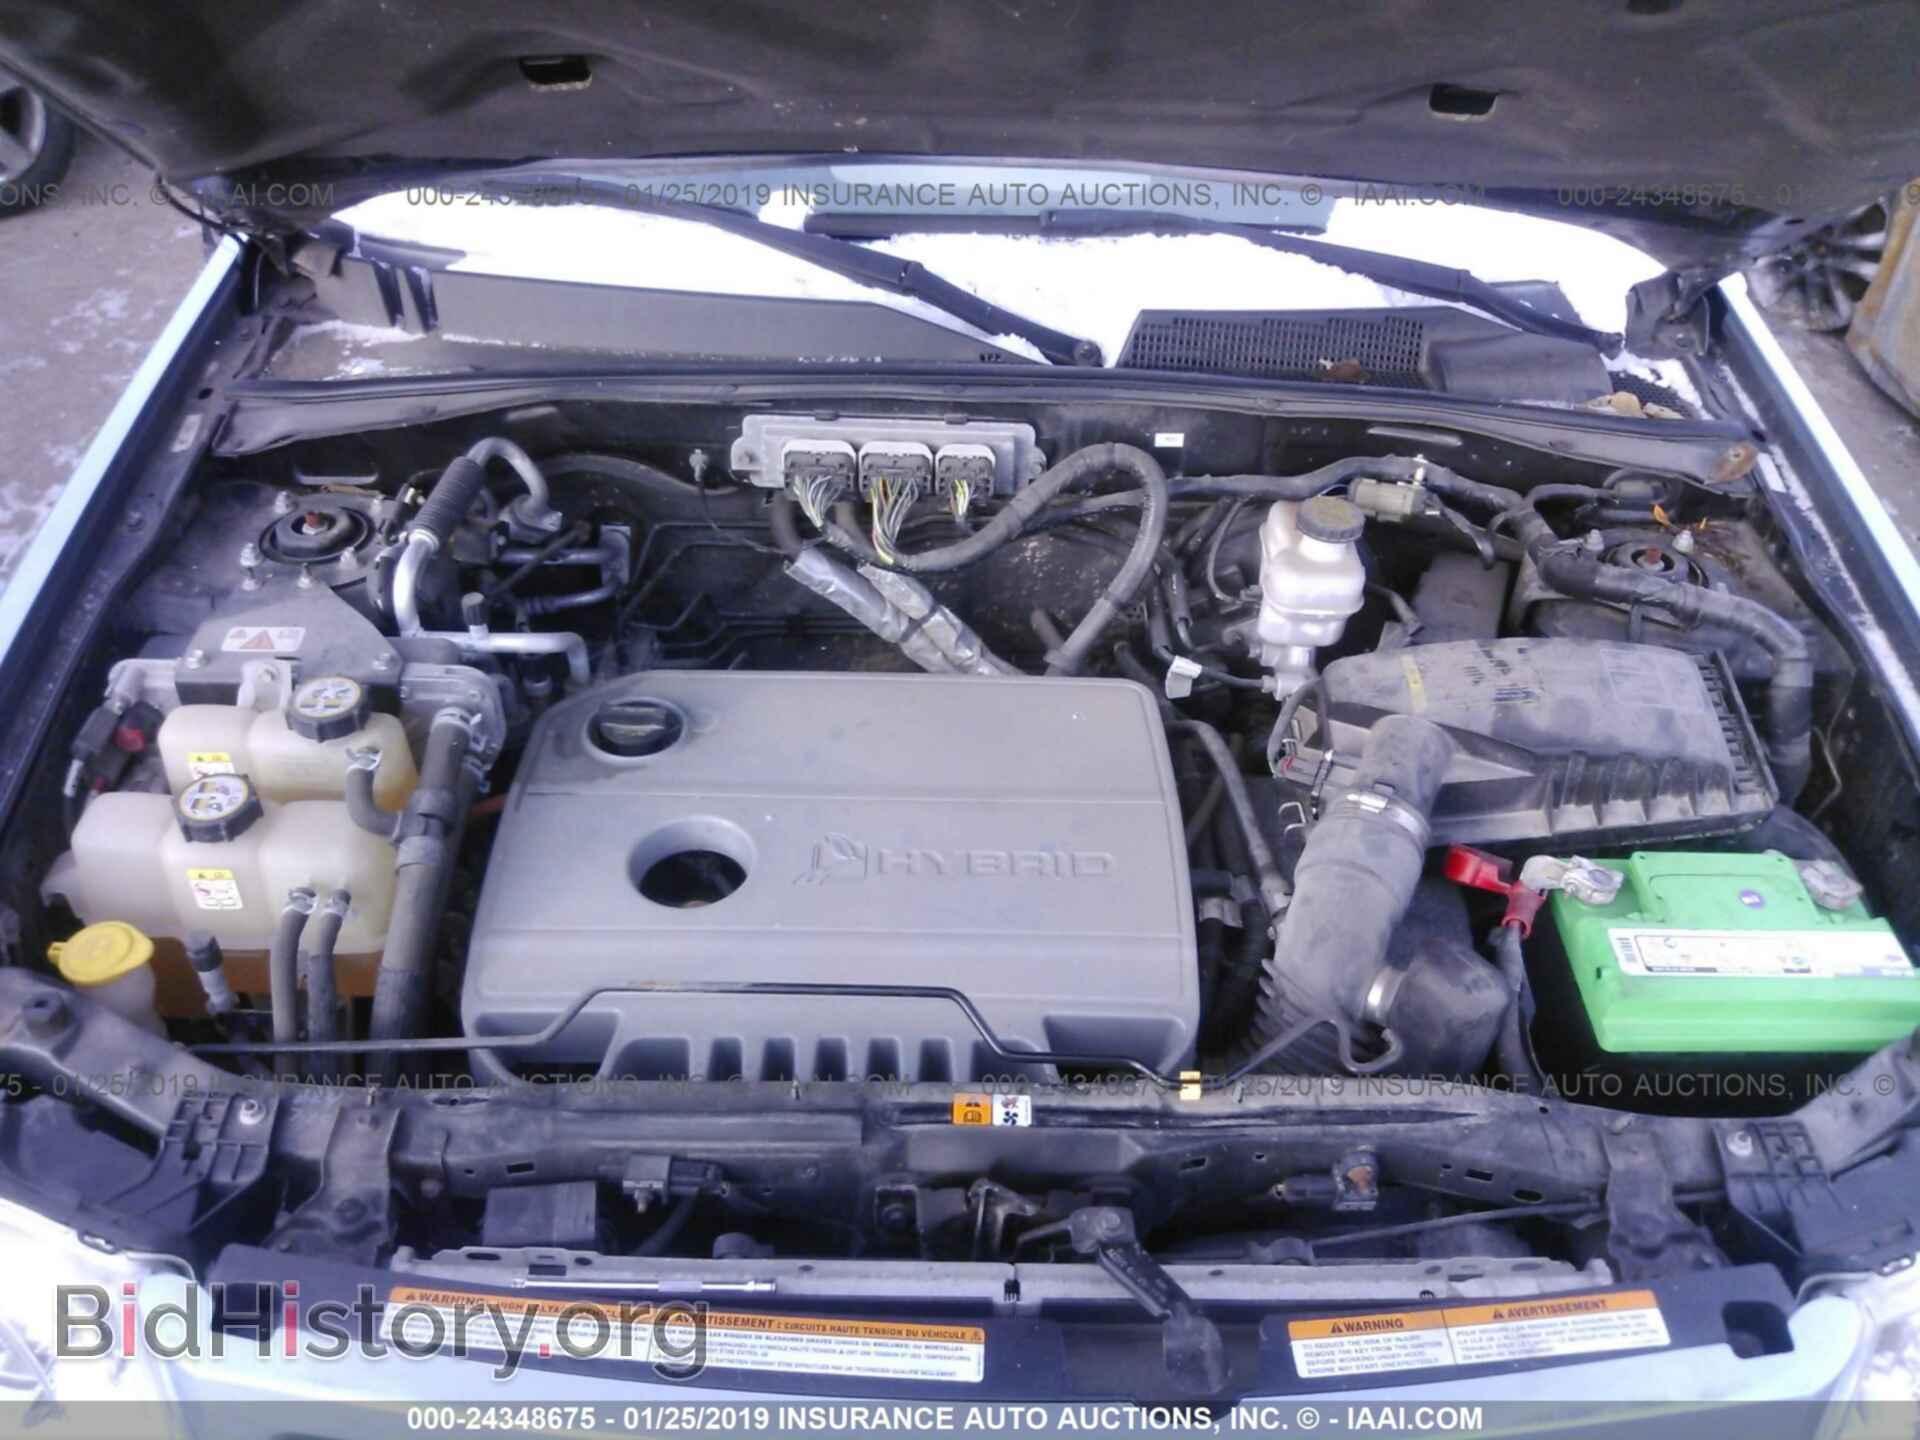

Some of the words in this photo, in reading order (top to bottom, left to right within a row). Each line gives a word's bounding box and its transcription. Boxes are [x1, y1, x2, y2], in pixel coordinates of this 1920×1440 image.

[877, 848, 1114, 879] HYBRID
[1507, 1300, 1607, 1318] AVERTISSEMENT
[1344, 1318, 1404, 1332] WARNING
